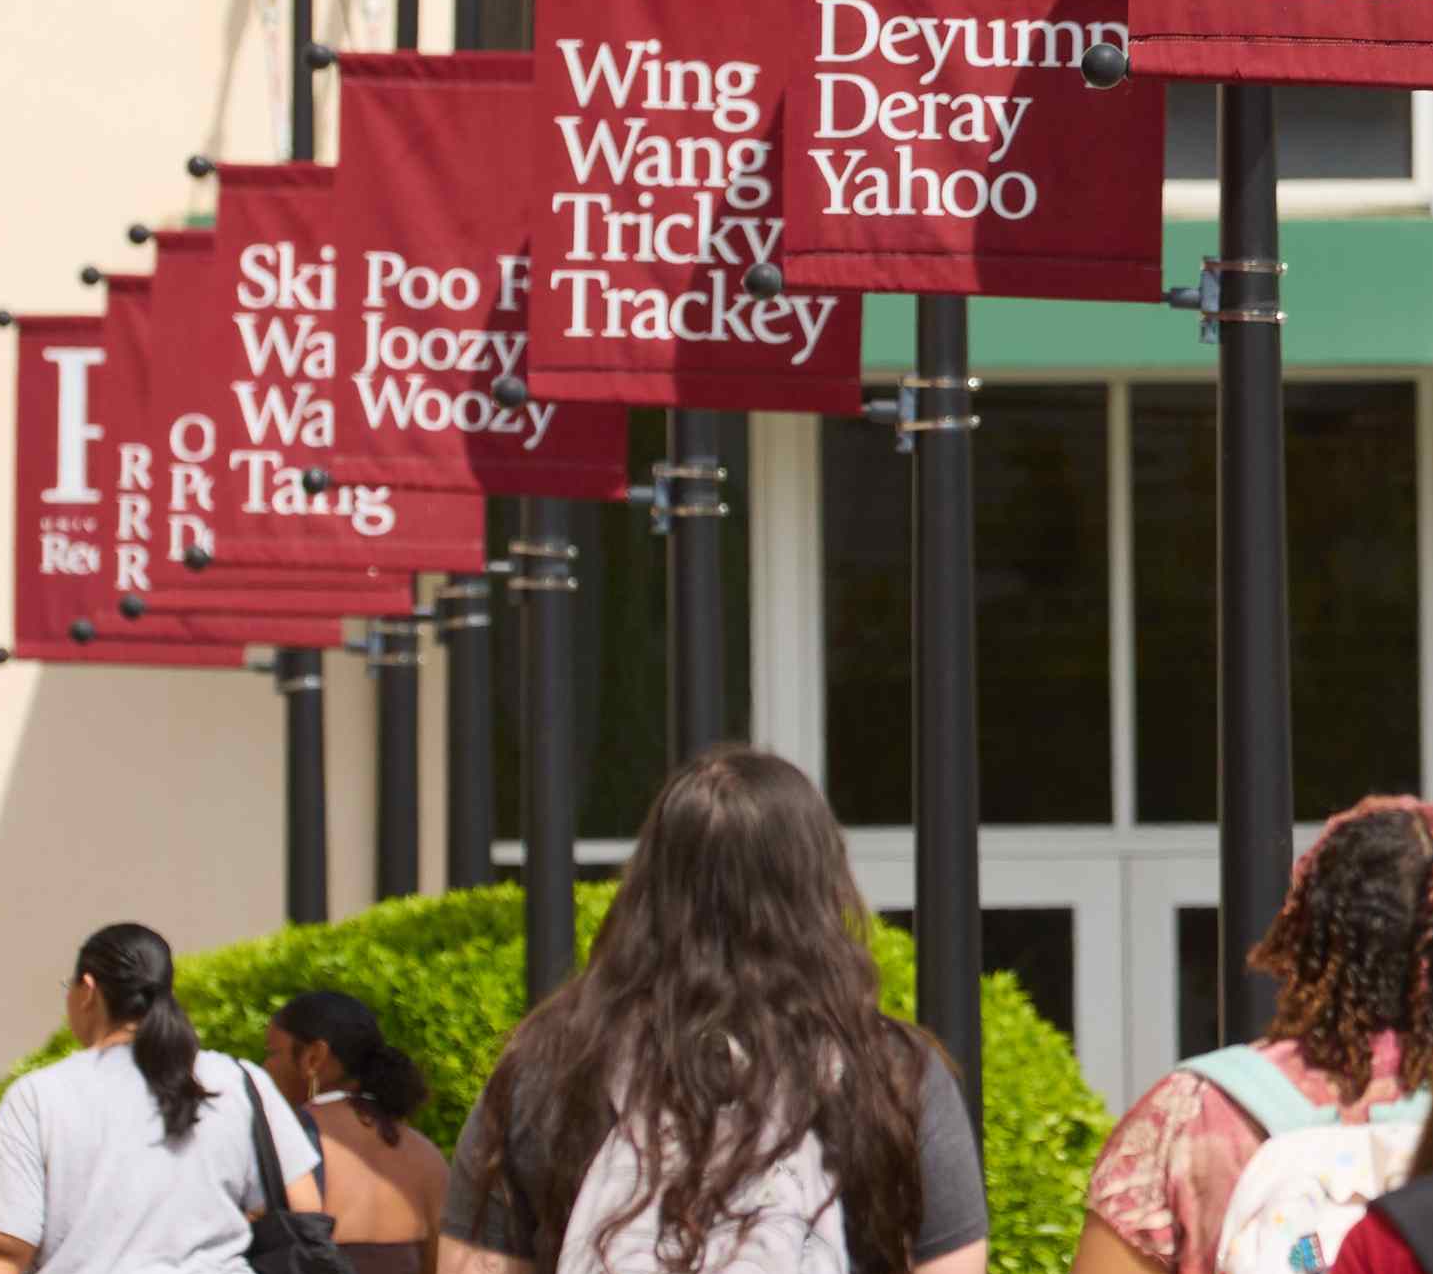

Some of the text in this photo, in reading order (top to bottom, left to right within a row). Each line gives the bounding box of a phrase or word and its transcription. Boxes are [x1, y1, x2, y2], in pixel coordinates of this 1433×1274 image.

[555, 38, 761, 134] Wing
[813, 72, 1033, 164] Deray
[552, 115, 772, 211] Wang
[806, 146, 1038, 221] Yahoo
[551, 191, 784, 267] Tricky
[236, 241, 336, 311] Ski
[365, 251, 480, 311] Poo
[233, 312, 336, 379] Wa
[361, 311, 527, 378] Joozy
[550, 268, 840, 366] Trackey
[231, 380, 335, 448] Wa
[352, 373, 556, 451] Woozy
